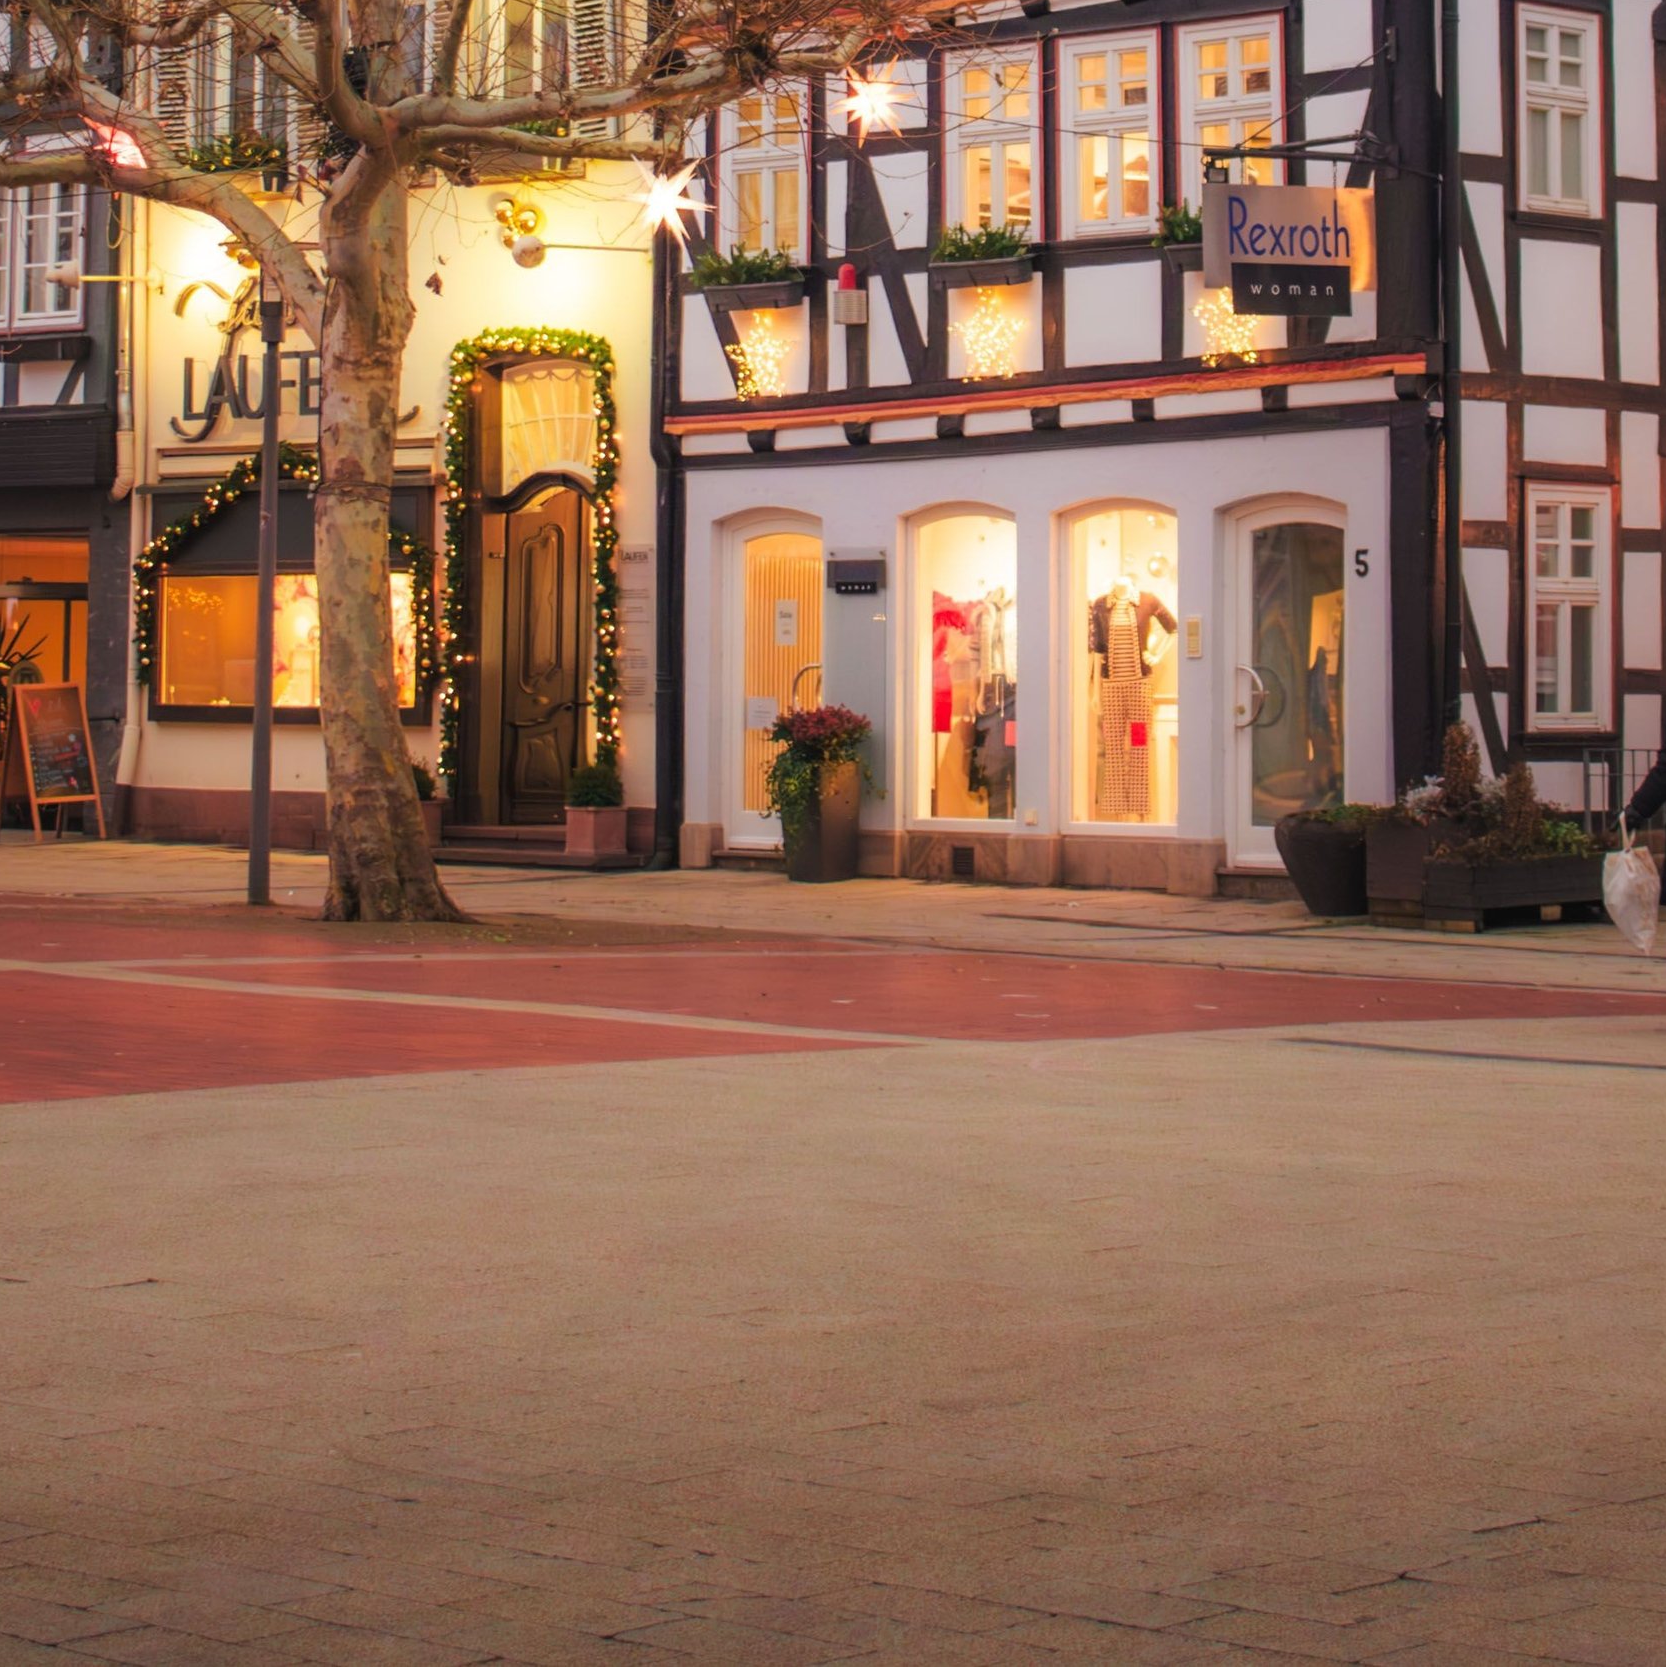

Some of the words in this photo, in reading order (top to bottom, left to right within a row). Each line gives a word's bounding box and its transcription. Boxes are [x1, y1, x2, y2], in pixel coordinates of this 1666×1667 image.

[1228, 196, 1350, 258] Rexroth
[1250, 284, 1334, 297] woman
[183, 350, 323, 420] LAUFE
[1355, 549, 1369, 577] 5
